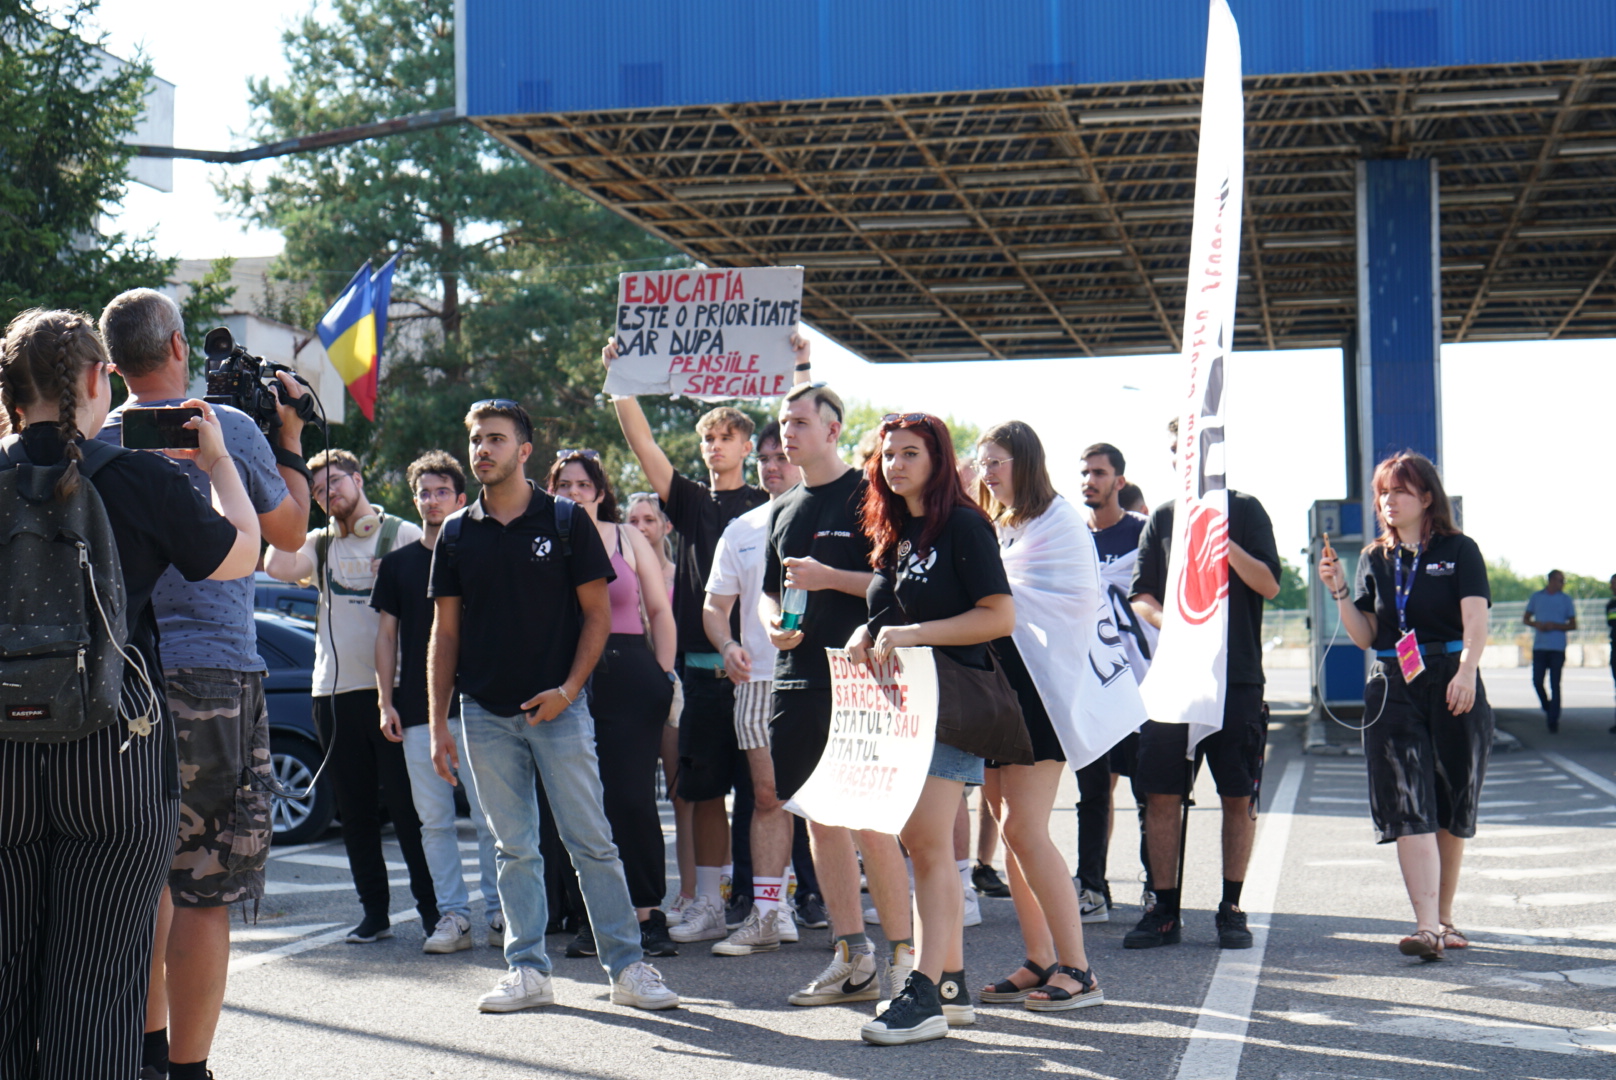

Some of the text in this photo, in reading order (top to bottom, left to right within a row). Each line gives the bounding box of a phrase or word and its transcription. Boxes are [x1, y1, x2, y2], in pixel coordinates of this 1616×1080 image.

[618, 298, 799, 330] ESTE O PRIORITATE
[617, 330, 659, 357] DAR
[668, 351, 760, 373] PENSIILE
[683, 374, 787, 396] SPECIALE
[894, 713, 919, 738] SAU
[829, 737, 879, 762] STATUL
